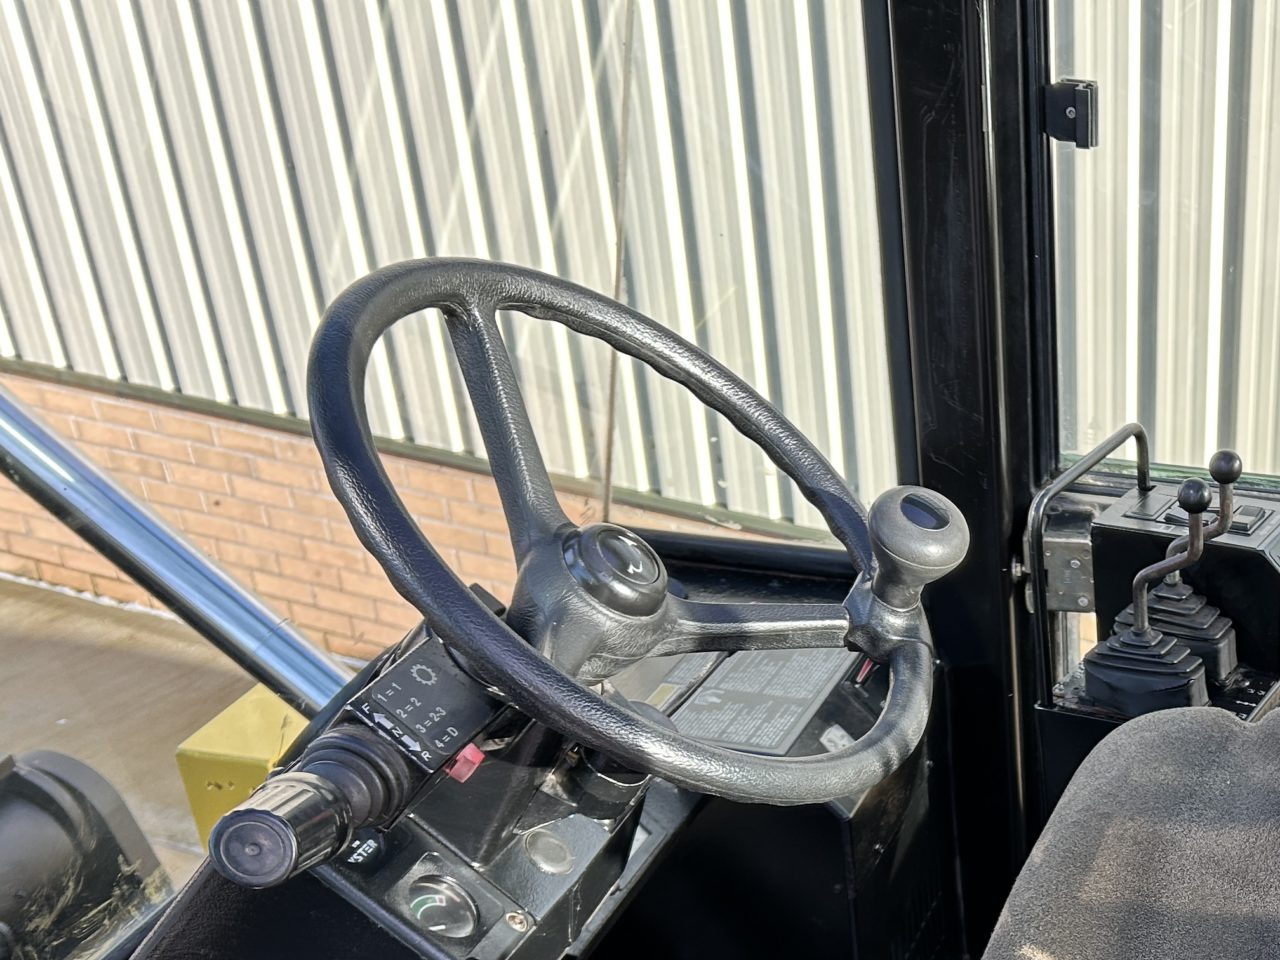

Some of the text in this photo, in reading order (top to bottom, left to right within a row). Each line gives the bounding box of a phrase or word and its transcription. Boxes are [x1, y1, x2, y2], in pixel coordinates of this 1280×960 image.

[361, 702, 371, 714] F
[396, 708, 408, 719] 2
[410, 697, 422, 707] 2
[392, 726, 403, 738] N
[415, 723, 427, 734] 3
[434, 739, 445, 750] 4
[447, 726, 459, 737] D
[420, 750, 432, 762] R
[347, 839, 378, 863] YSTER
